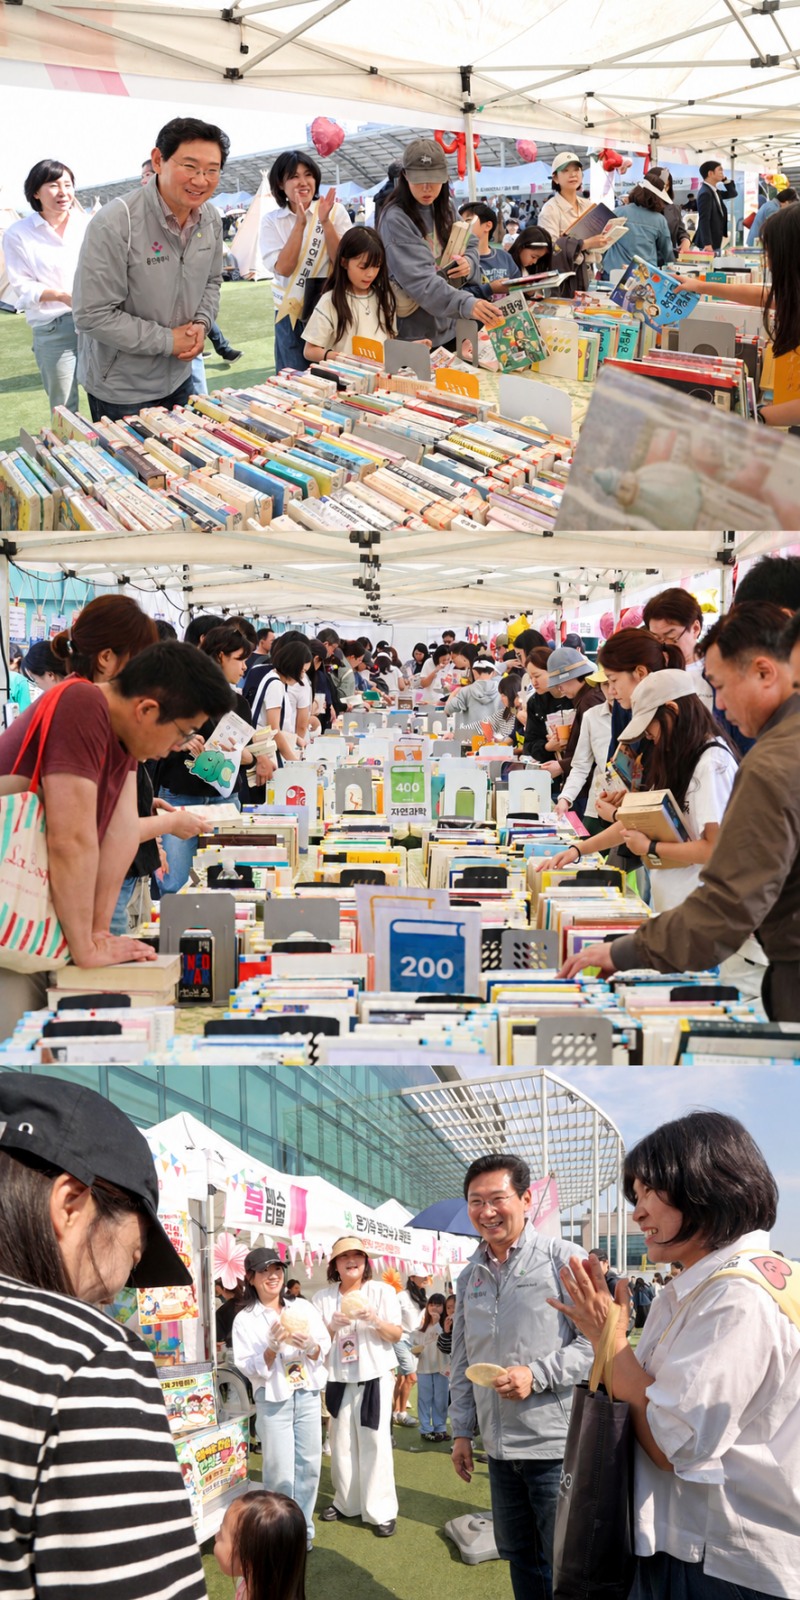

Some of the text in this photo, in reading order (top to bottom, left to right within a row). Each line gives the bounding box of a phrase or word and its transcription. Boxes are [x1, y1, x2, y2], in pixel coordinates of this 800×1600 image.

[395, 782, 420, 793] 400
[390, 807, 427, 816] 자연과학
[400, 956, 454, 979] 200
[244, 1185, 264, 1223] 북
